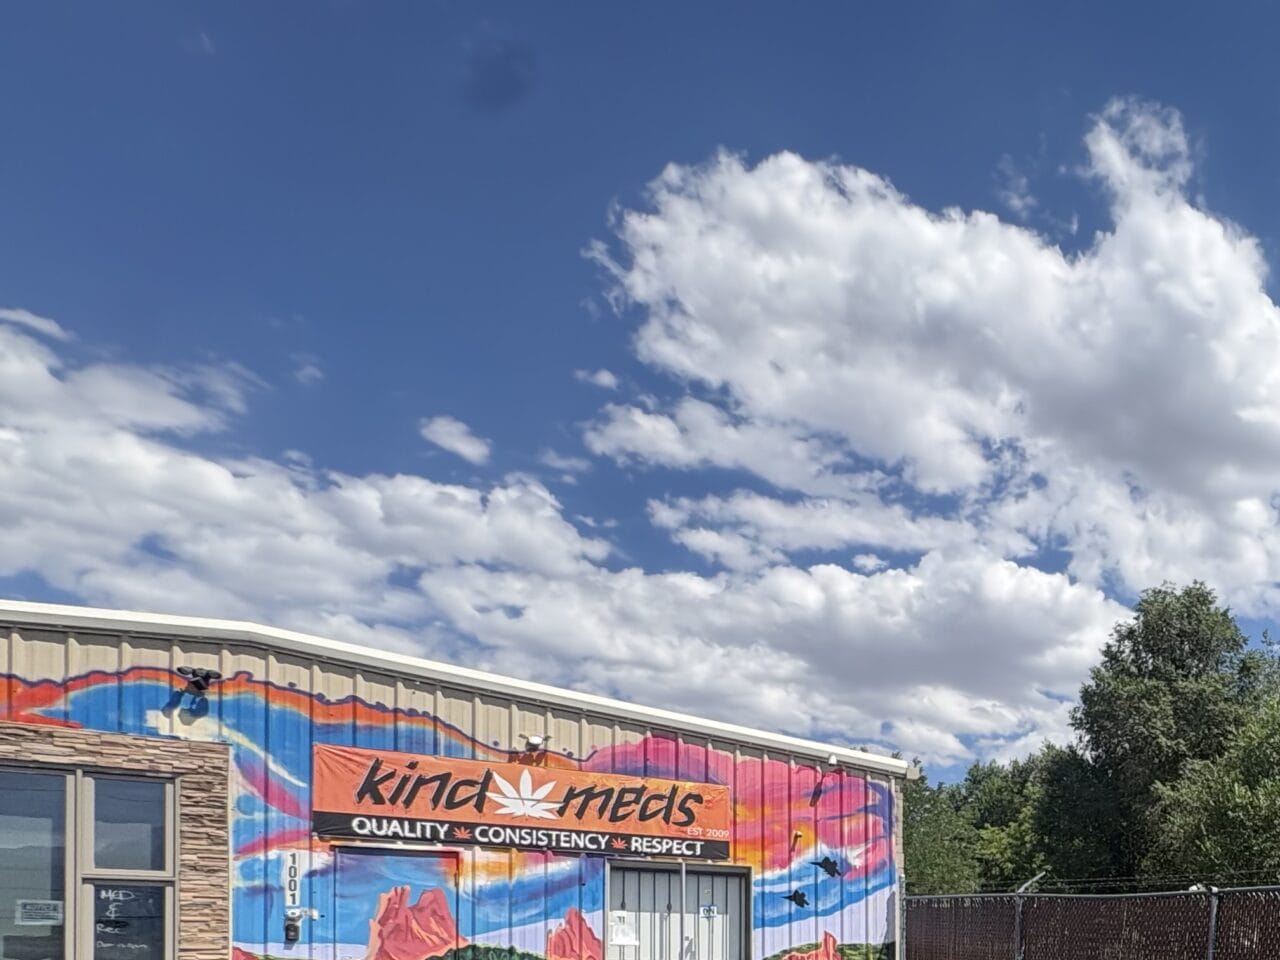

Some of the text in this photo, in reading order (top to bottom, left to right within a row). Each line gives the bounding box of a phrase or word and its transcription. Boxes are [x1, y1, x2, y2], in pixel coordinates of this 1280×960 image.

[356, 757, 703, 827] kind meds
[352, 817, 704, 855] QUALITY CONSISTENCY RESPECT
[687, 827, 729, 838] EST 2009
[288, 853, 297, 905] 1001
